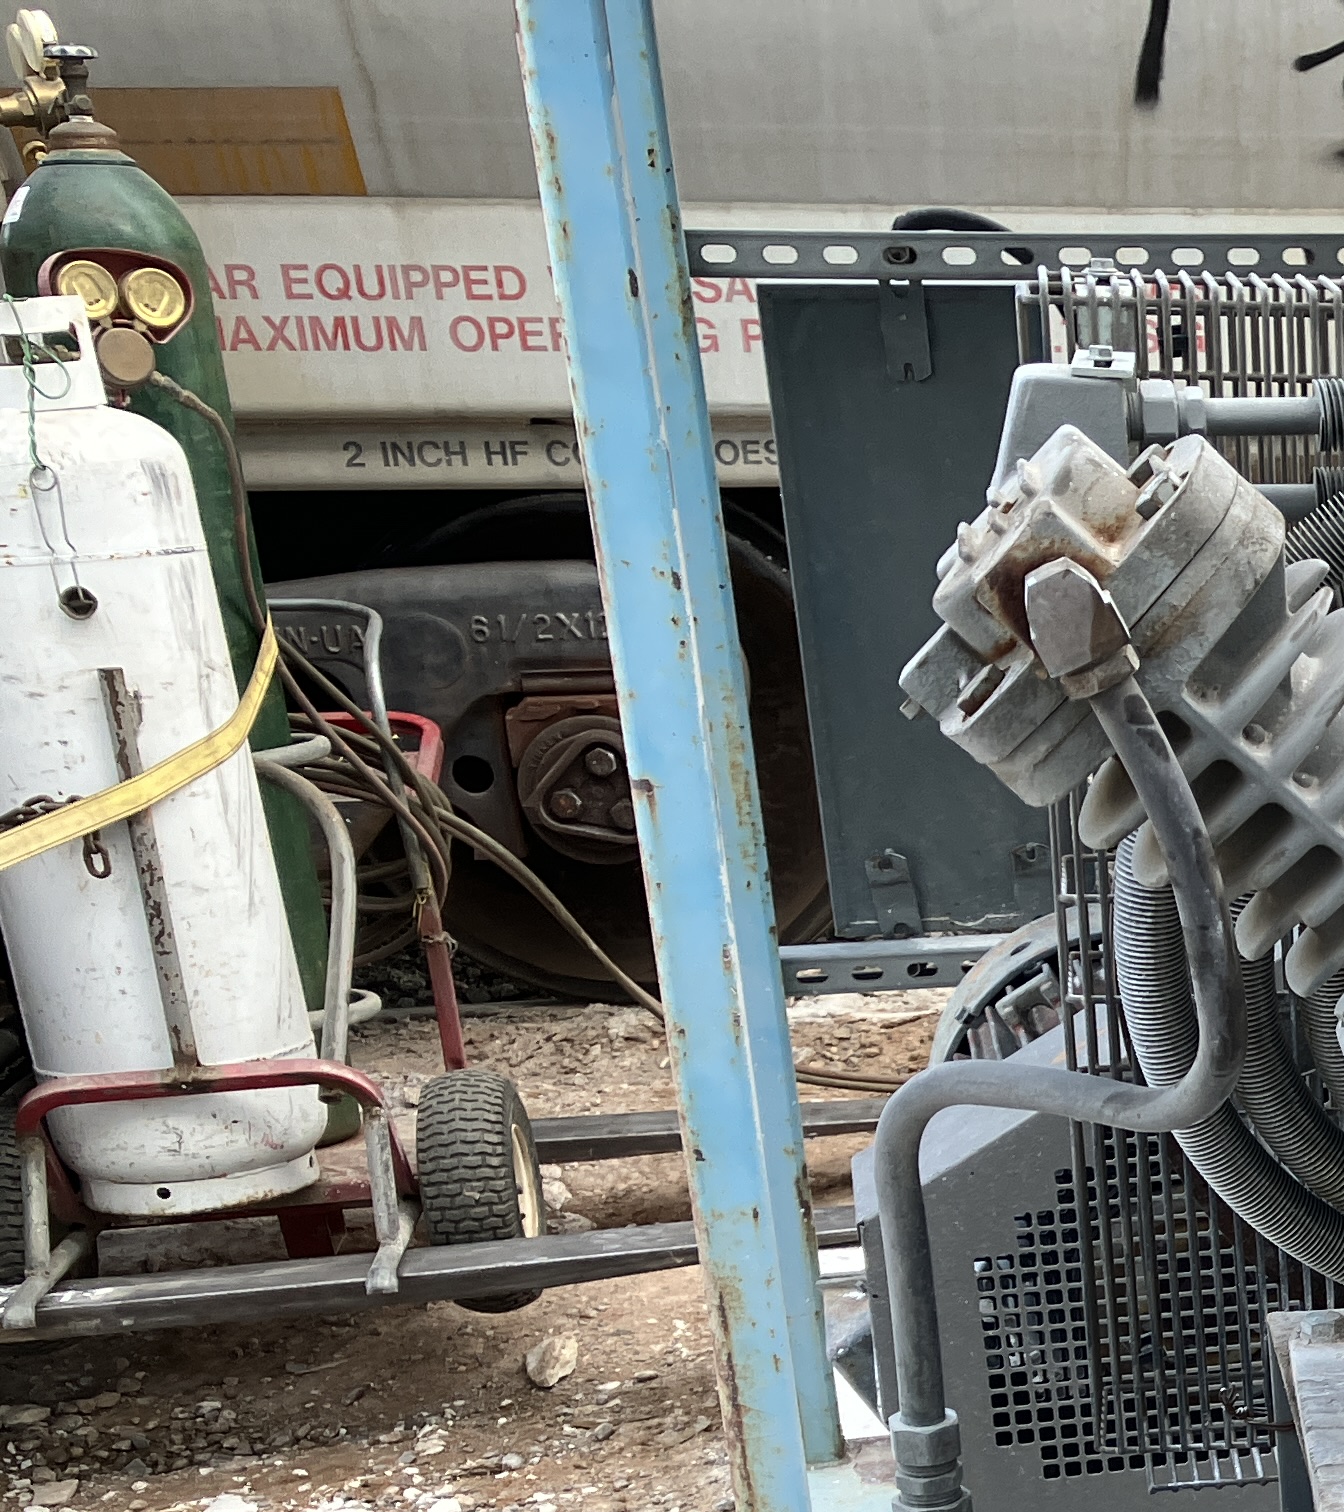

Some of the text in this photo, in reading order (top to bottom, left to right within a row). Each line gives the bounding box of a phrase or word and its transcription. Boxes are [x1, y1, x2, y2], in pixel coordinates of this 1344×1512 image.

[207, 264, 528, 302] AR EQUIPPED
[214, 316, 428, 352] AXIMUM
[342, 441, 367, 468] 2
[381, 441, 469, 468] INCH
[485, 440, 529, 467] HF
